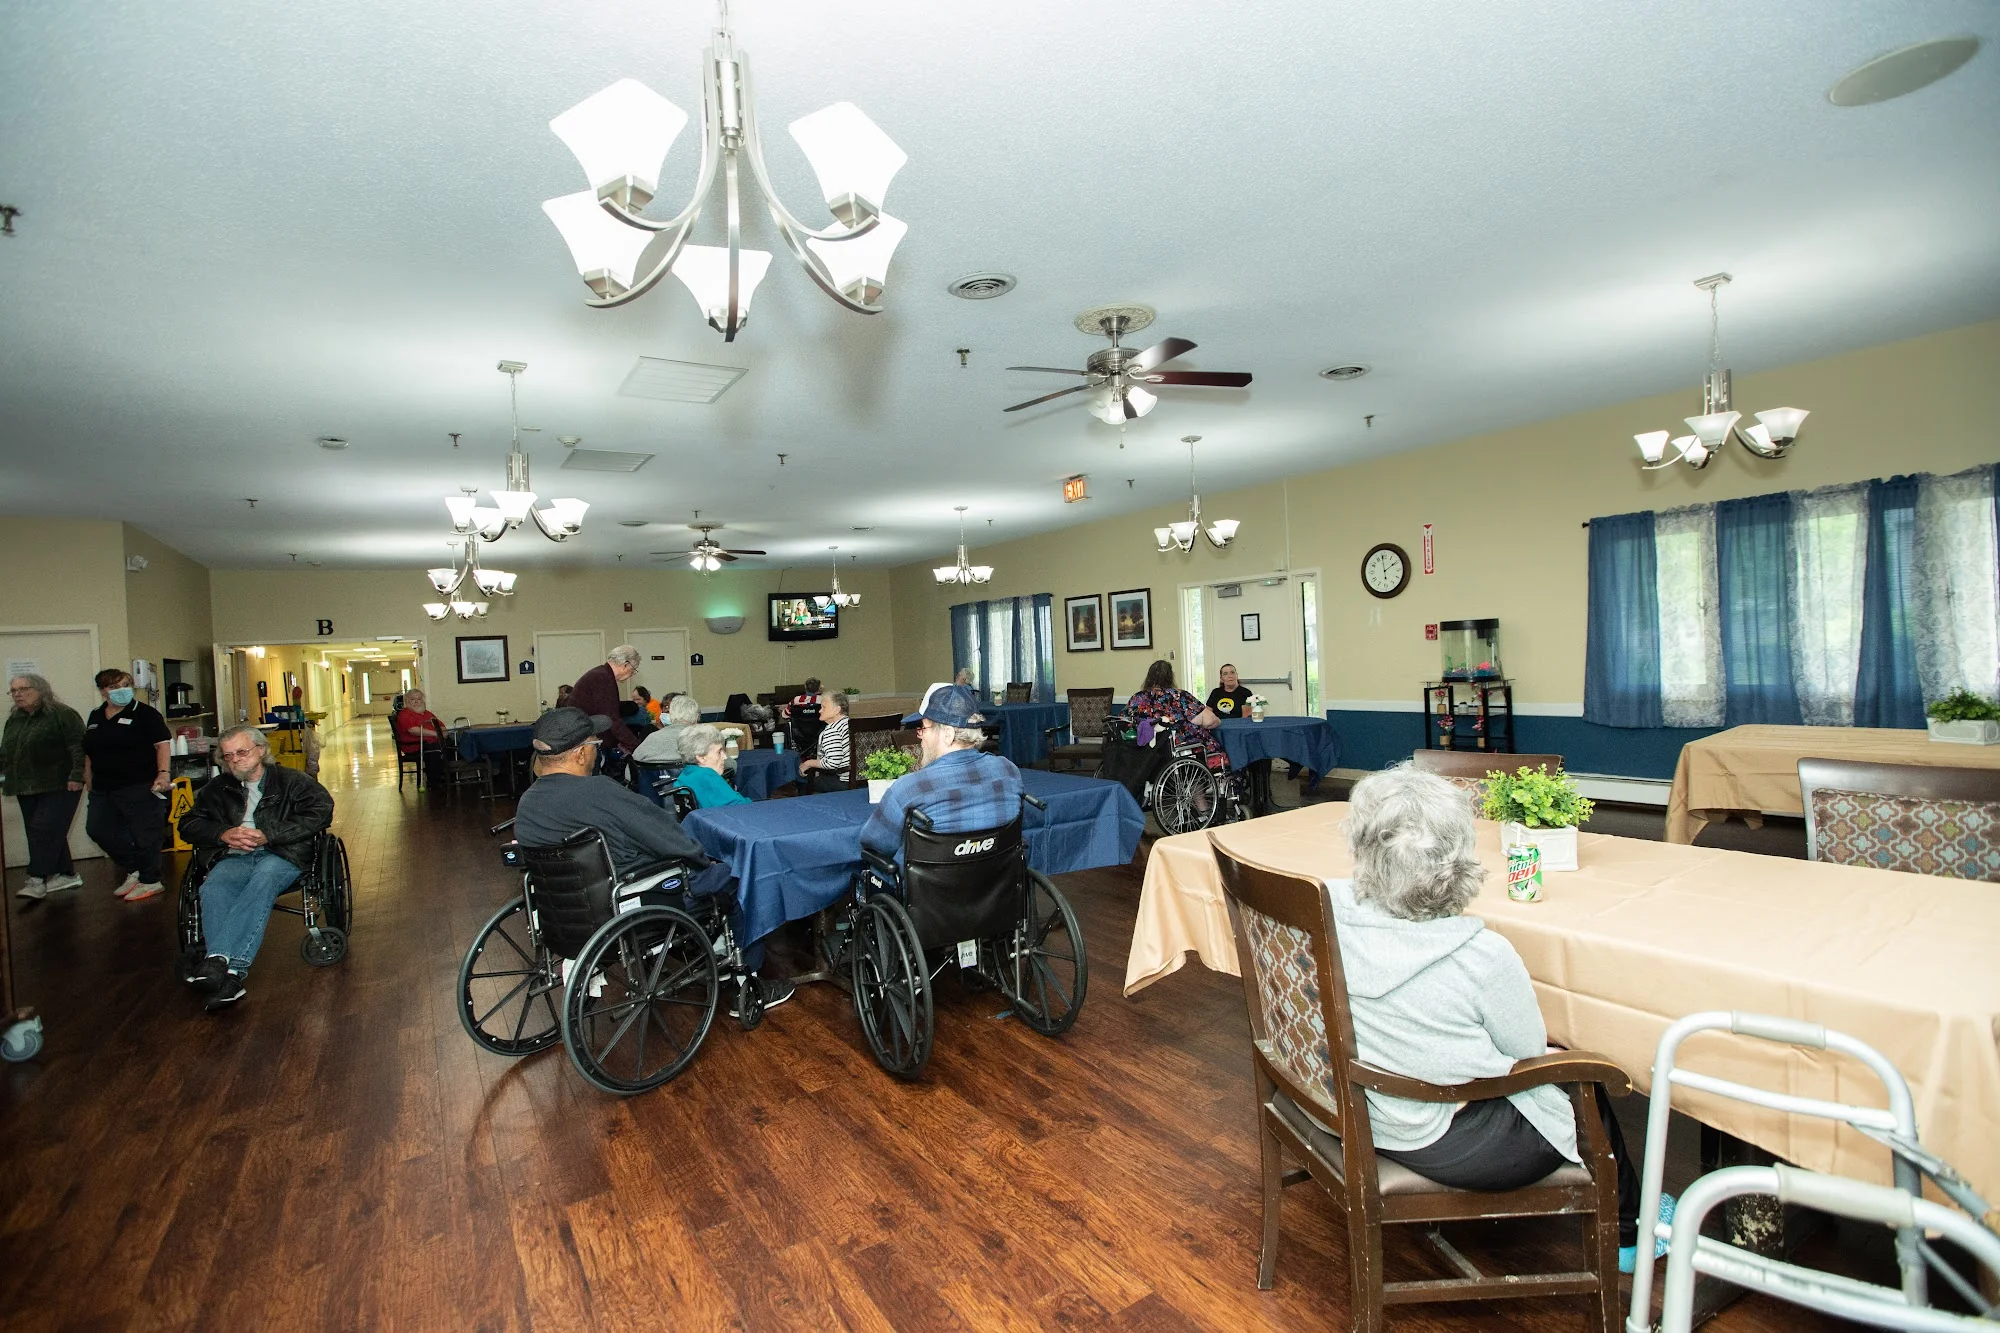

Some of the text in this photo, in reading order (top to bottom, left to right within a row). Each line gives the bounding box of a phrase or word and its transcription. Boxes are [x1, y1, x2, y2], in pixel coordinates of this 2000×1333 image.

[1066, 480, 1084, 499] EXIT
[316, 619, 334, 636] B
[954, 837, 995, 856] drive
